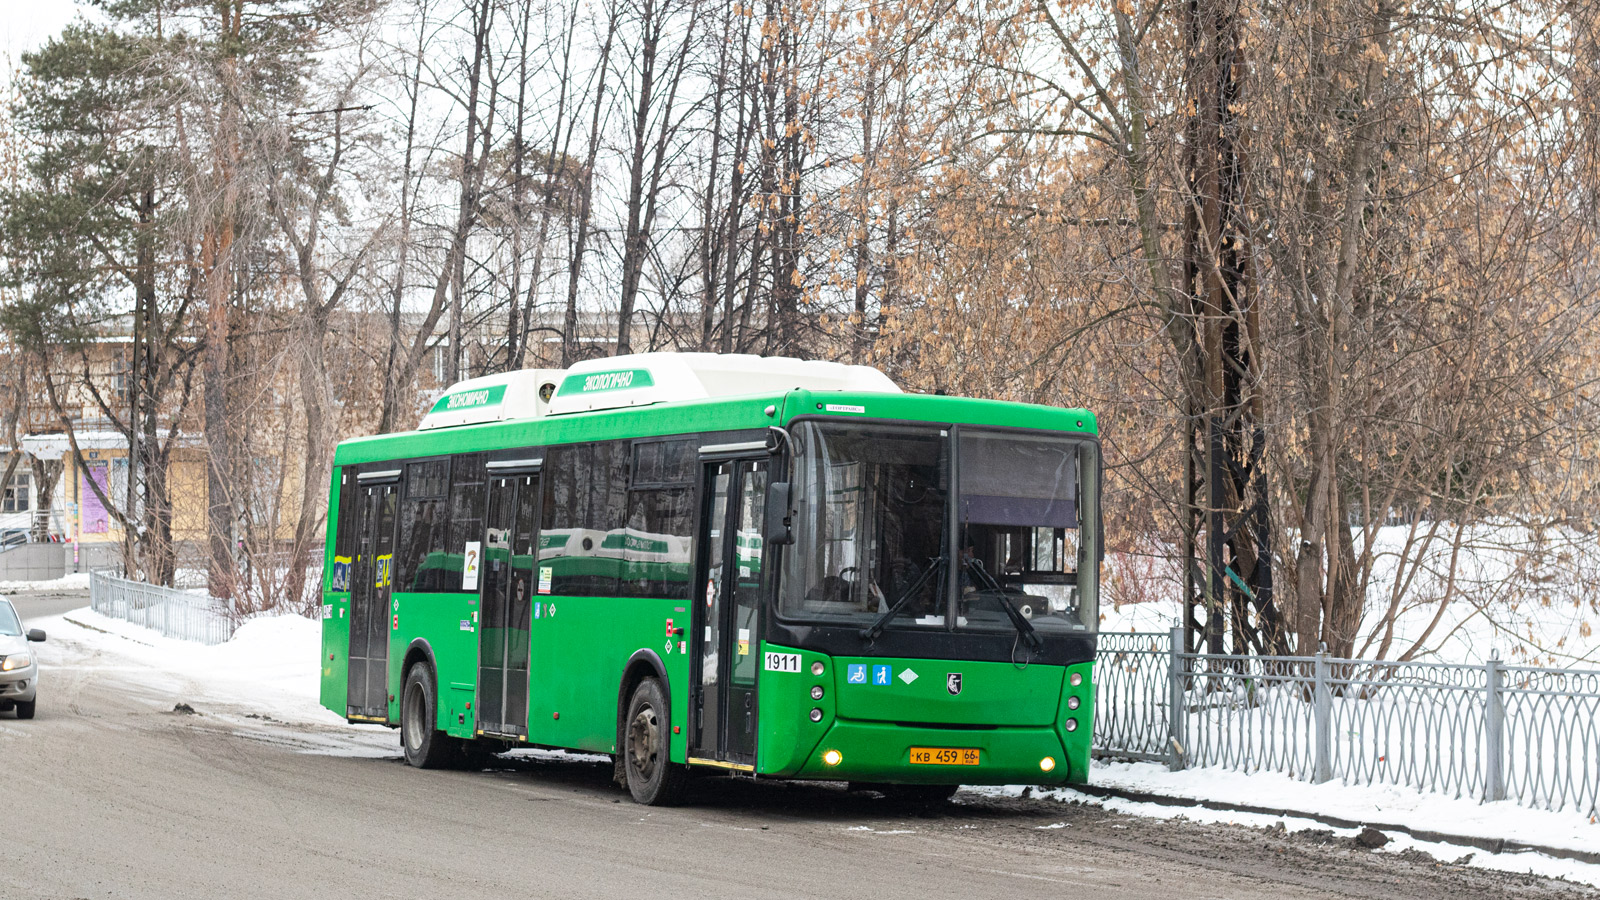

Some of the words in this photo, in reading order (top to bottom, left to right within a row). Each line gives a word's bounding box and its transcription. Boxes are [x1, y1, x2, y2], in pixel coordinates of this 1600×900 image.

[583, 370, 633, 391] ЭКОЛОГИЧНО
[447, 390, 489, 409] ЭКОНОМИЧНО
[767, 654, 797, 671] 1911
[936, 750, 958, 763] 459
[964, 750, 976, 760] 66
